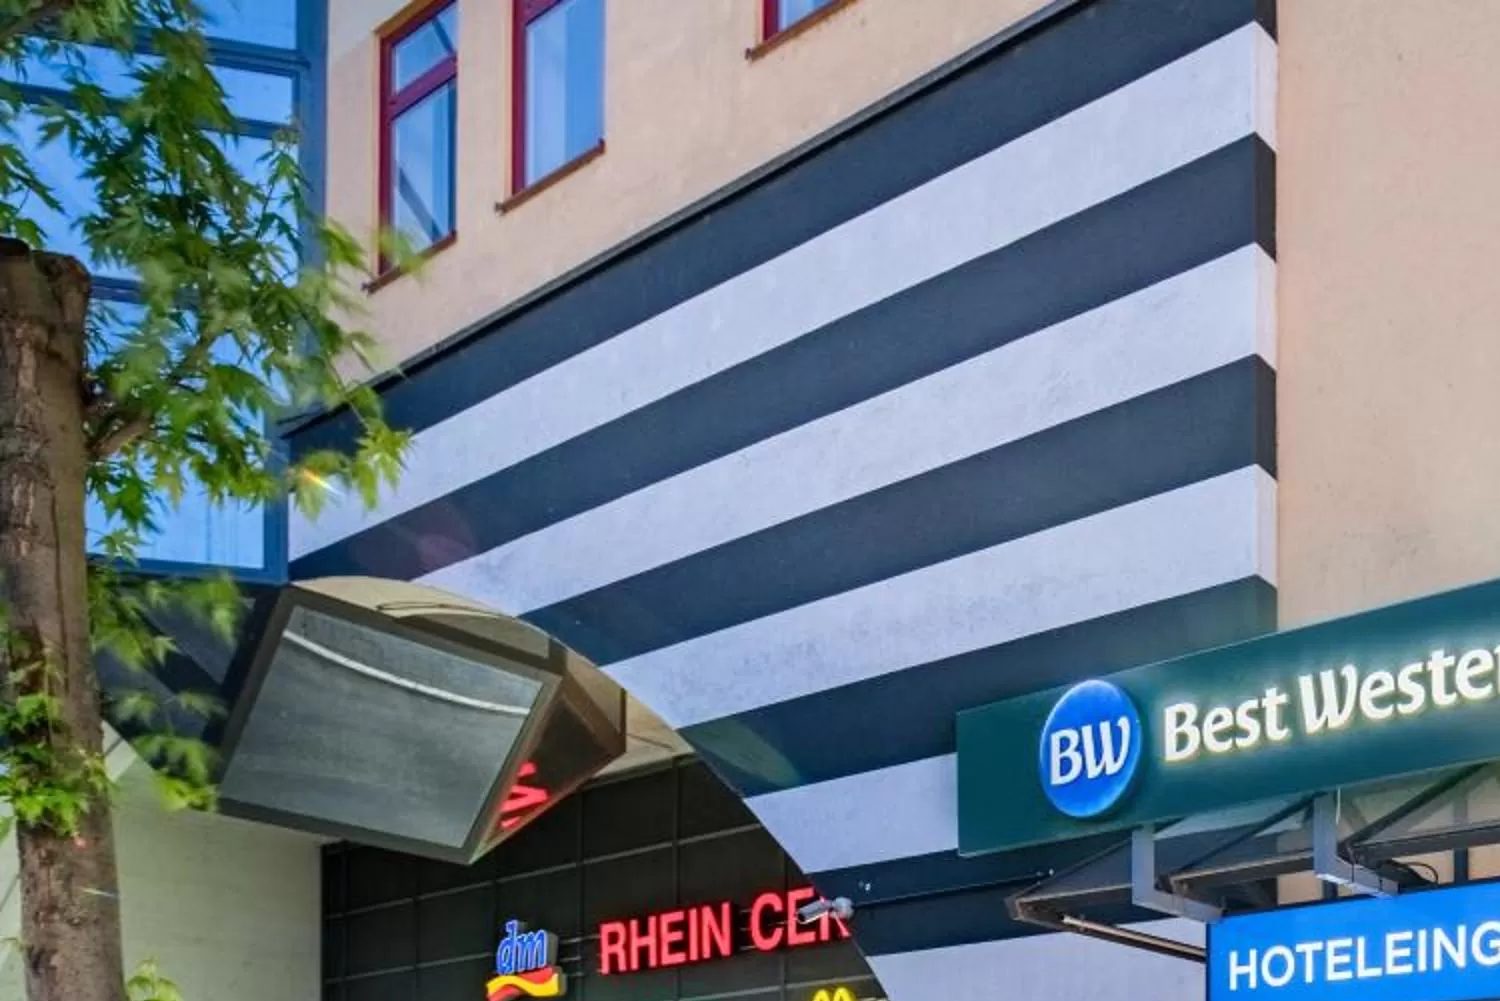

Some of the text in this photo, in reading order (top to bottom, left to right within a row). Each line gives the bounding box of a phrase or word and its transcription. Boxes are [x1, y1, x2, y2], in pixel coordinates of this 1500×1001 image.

[1049, 715, 1131, 787] BW
[1164, 688, 1289, 762] Best
[496, 919, 548, 975] dm
[599, 901, 733, 976] RHEIN
